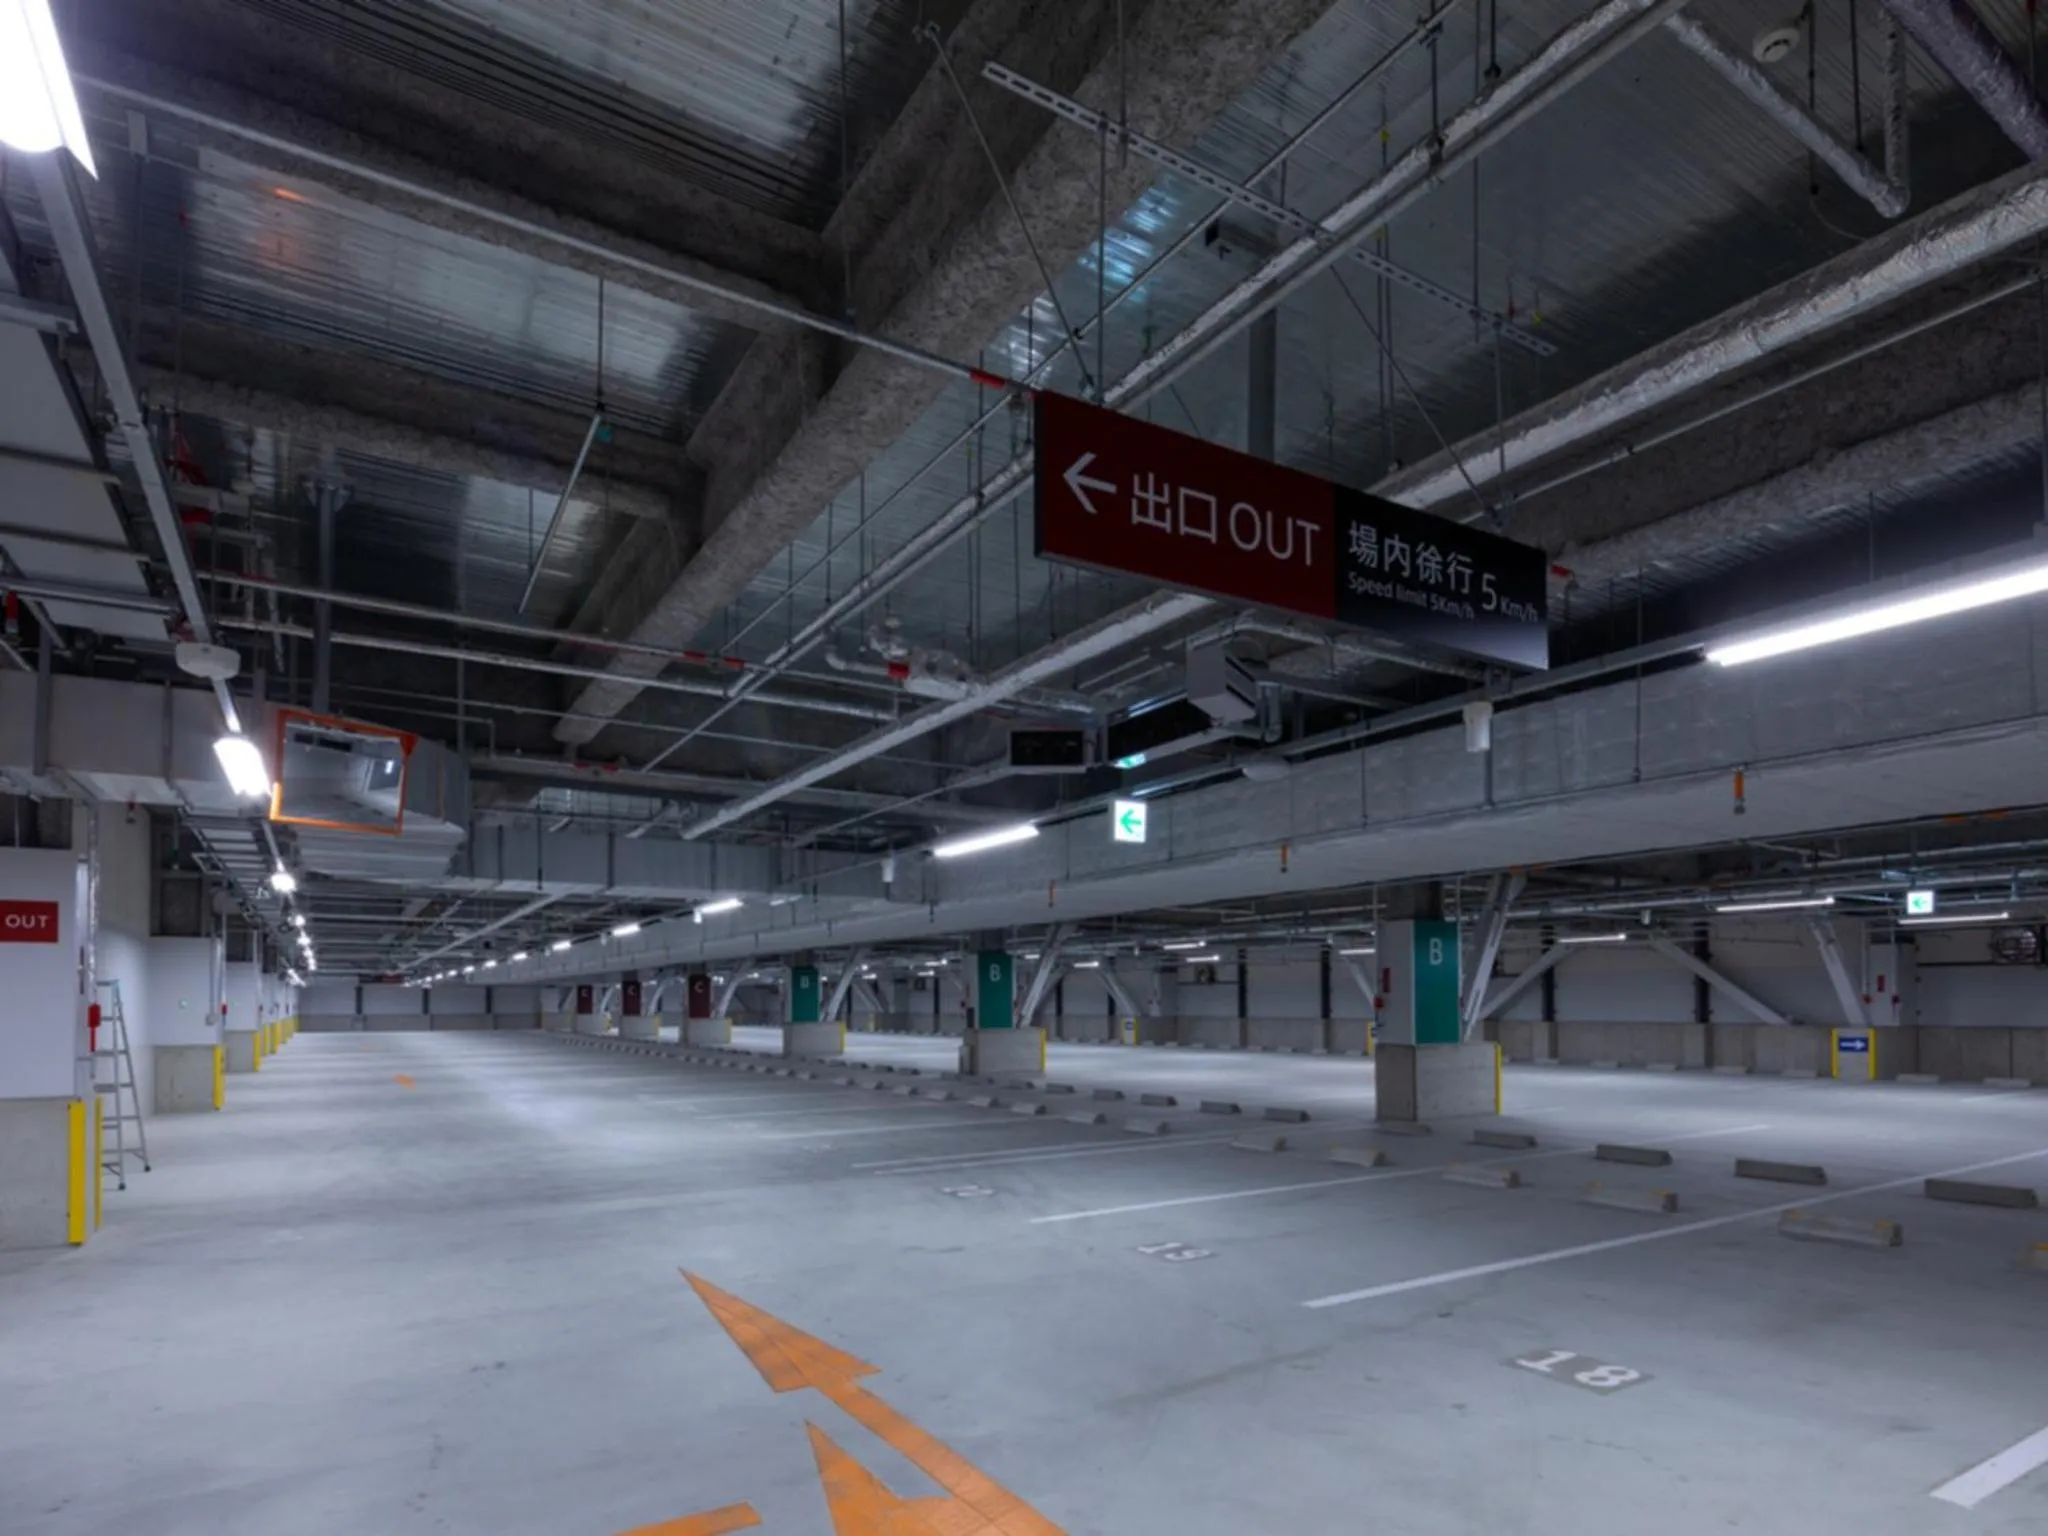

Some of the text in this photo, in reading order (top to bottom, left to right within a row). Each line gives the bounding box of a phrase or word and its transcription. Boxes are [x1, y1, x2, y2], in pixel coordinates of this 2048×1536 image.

[1131, 471, 1320, 566] 出口 OUT
[1348, 520, 1474, 595] 場内徐行
[1481, 572, 1497, 611] 5
[1348, 571, 1393, 597] Speed
[5, 914, 49, 929] OUT
[1429, 937, 1443, 966] B
[989, 963, 1001, 982] B
[694, 981, 705, 993] C
[1515, 1350, 1640, 1388] 18
